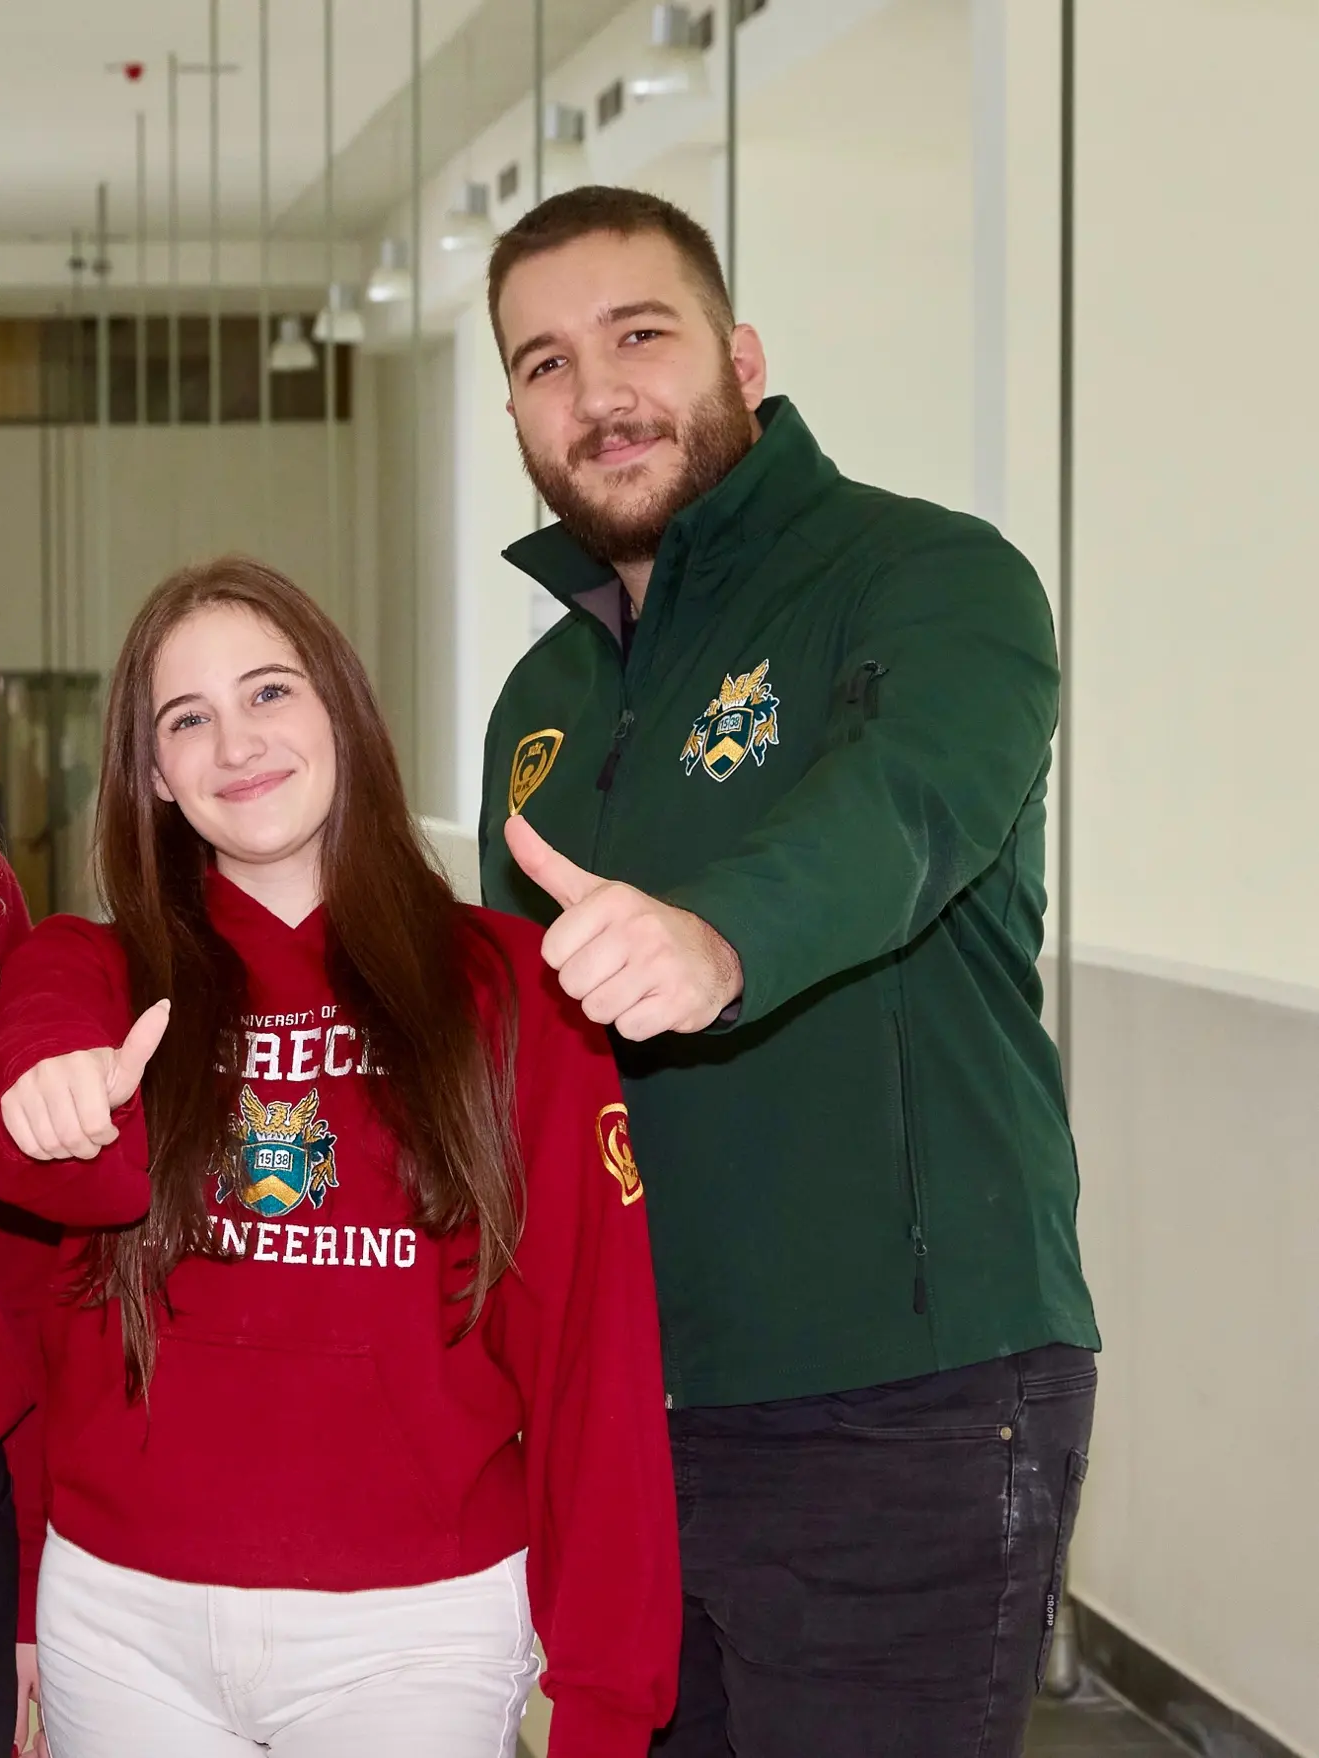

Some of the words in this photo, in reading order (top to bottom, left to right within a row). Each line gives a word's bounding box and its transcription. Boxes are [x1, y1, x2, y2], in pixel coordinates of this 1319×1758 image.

[240, 1010, 315, 1027] NIVERSIT
[321, 1005, 341, 1019] OF
[206, 1214, 416, 1269] NEERING
[1046, 1594, 1055, 1627] CROPP
